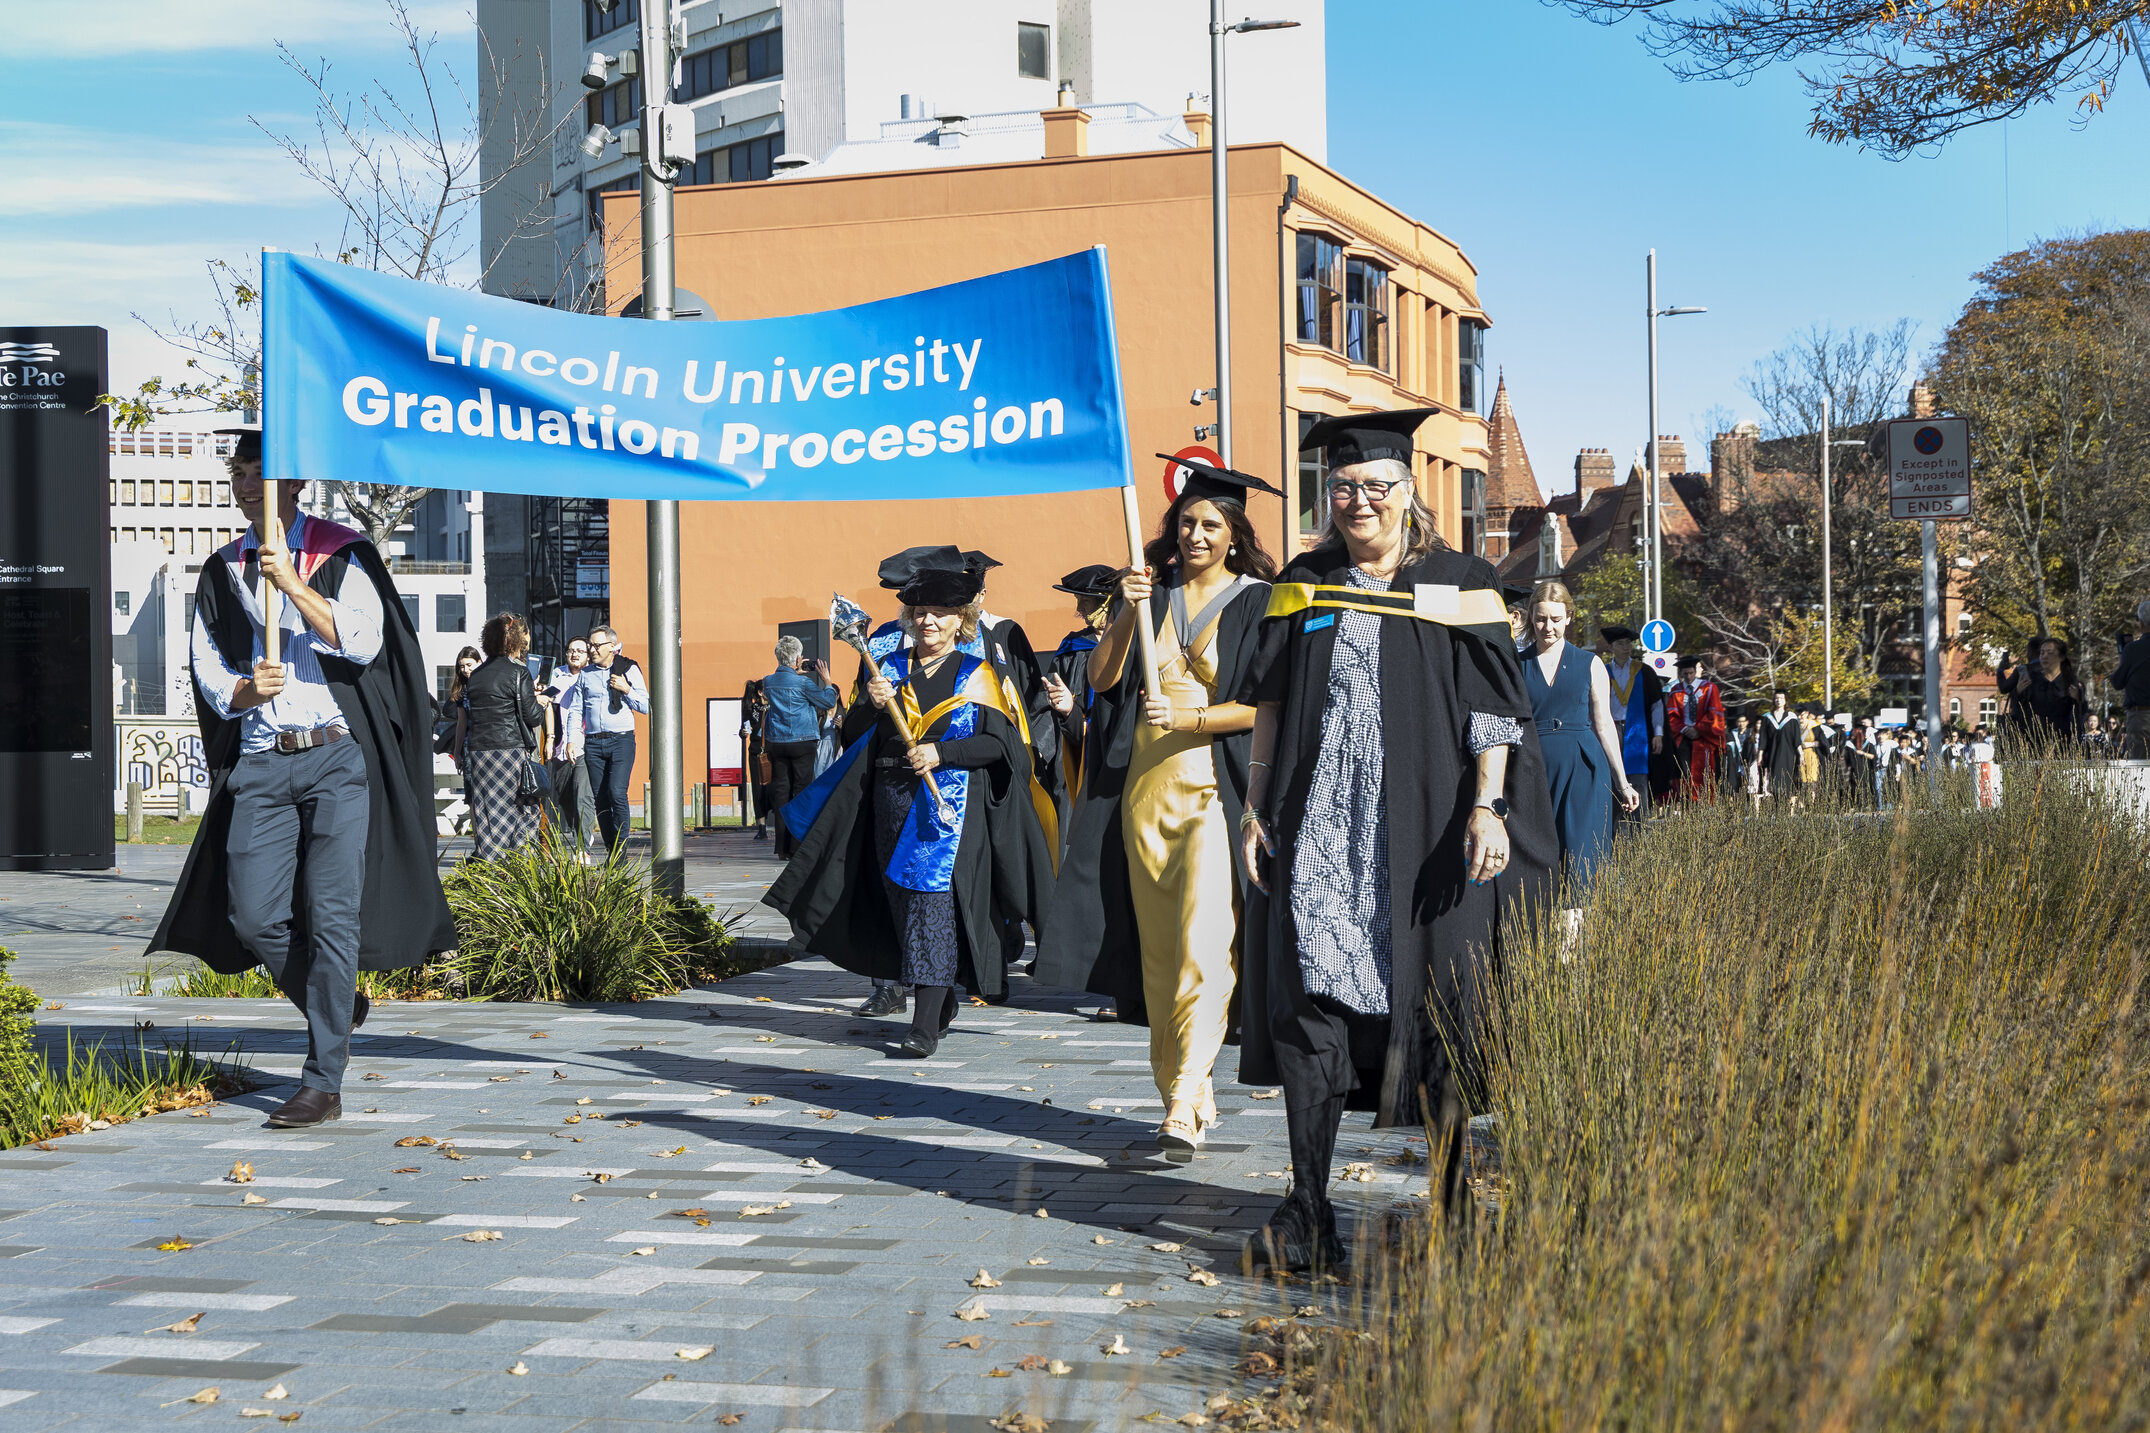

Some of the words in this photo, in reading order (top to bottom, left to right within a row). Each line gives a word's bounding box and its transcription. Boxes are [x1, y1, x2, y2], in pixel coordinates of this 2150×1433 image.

[426, 316, 659, 399] Lincoln
[683, 335, 982, 404] University
[21, 366, 65, 386] Pae
[9, 392, 58, 400] Christchurch
[0, 401, 38, 409] onvention
[40, 401, 66, 409] Centre
[343, 375, 699, 460] Graduation
[718, 396, 1064, 469] Procession
[1902, 458, 1943, 469] Except
[1947, 458, 1958, 467] in
[1895, 468, 1964, 483] Signposted
[1913, 483, 1948, 492] Areas
[1908, 500, 1953, 513] ENDS
[36, 565, 64, 574] Square
